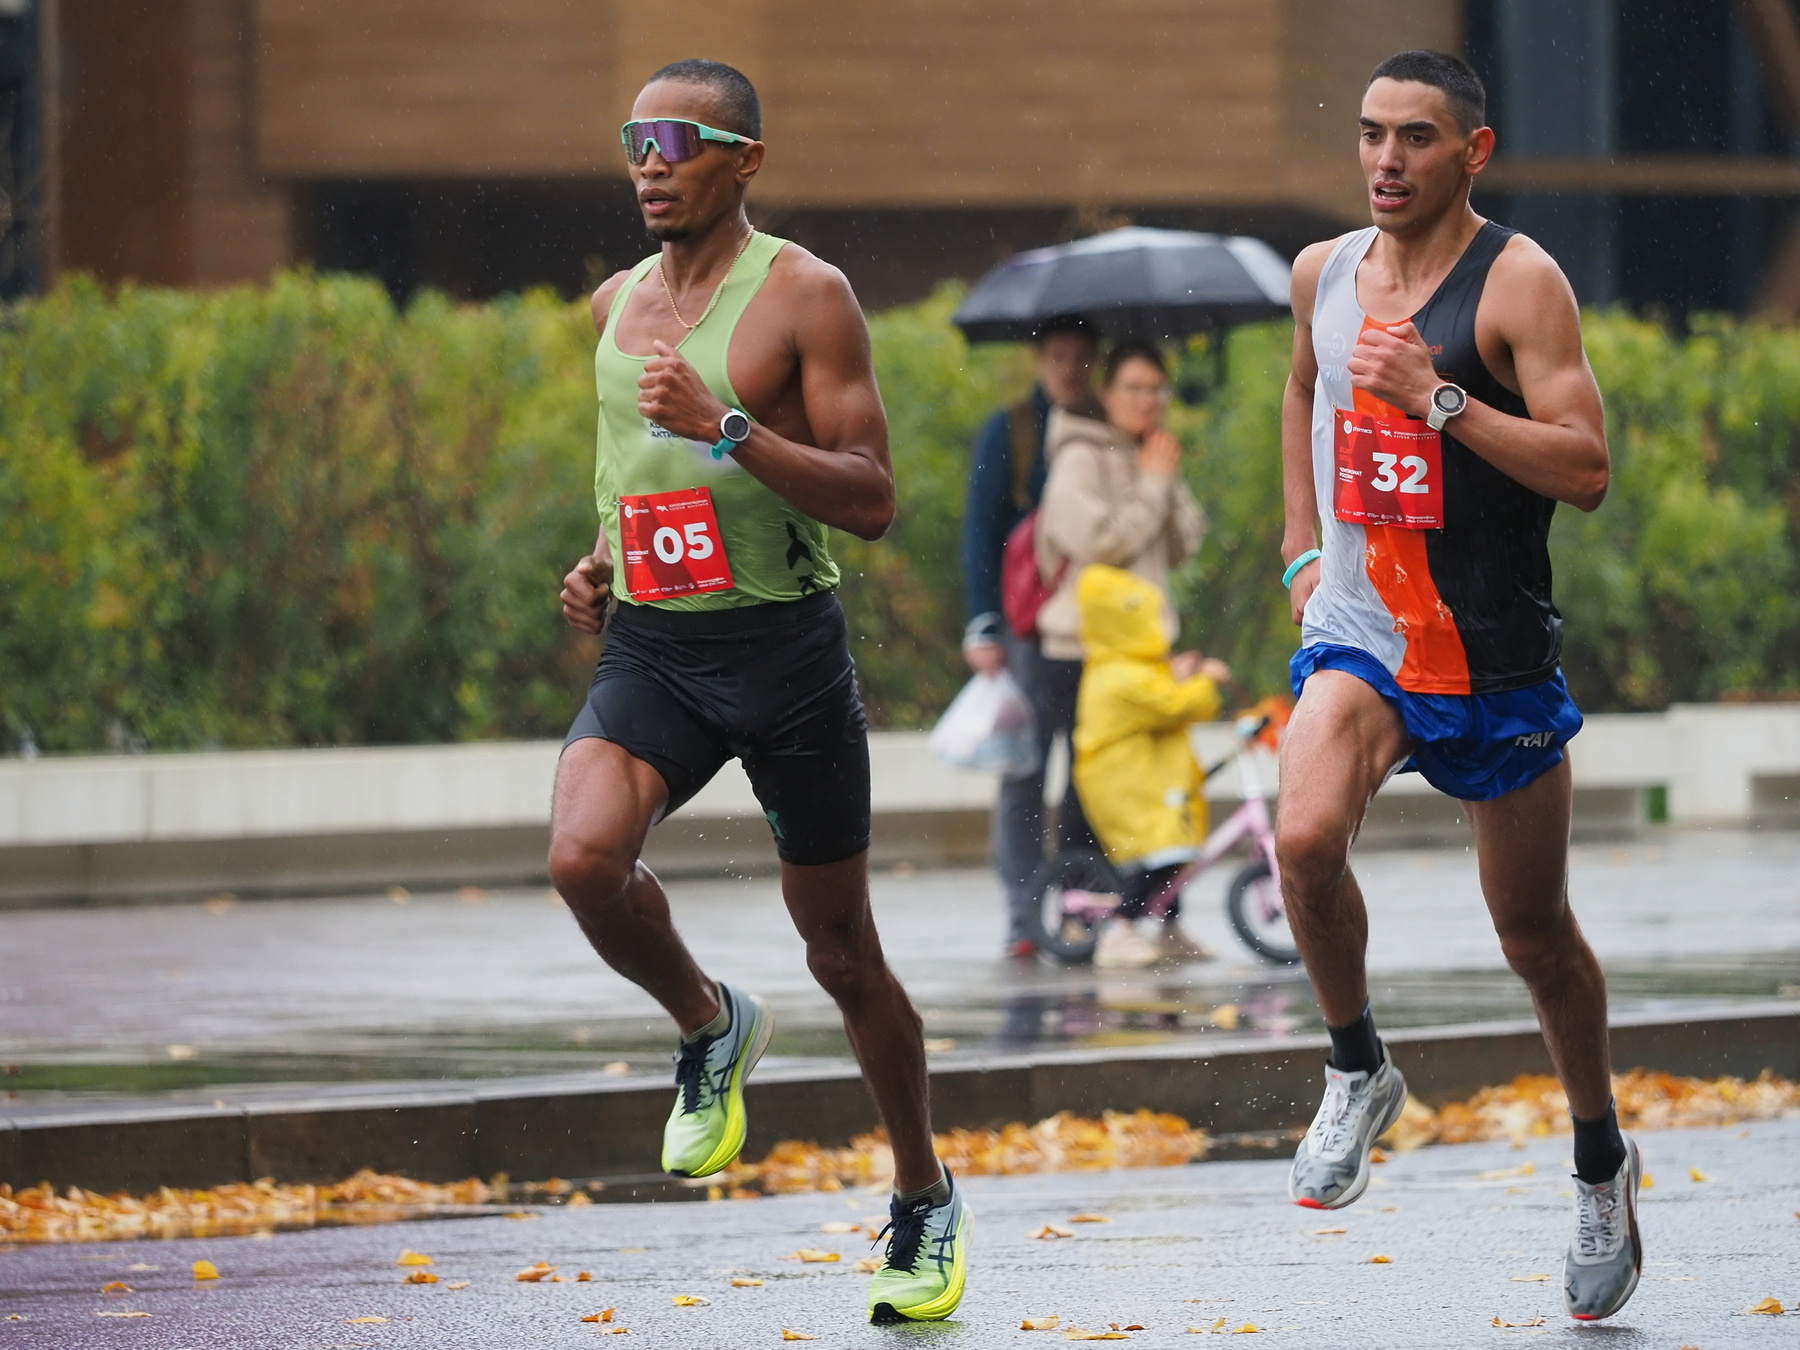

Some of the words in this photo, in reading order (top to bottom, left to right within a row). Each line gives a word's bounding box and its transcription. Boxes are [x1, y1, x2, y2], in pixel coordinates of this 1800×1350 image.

[1370, 451, 1429, 494] 32
[653, 521, 714, 565] 05
[1514, 731, 1555, 748] RAY
